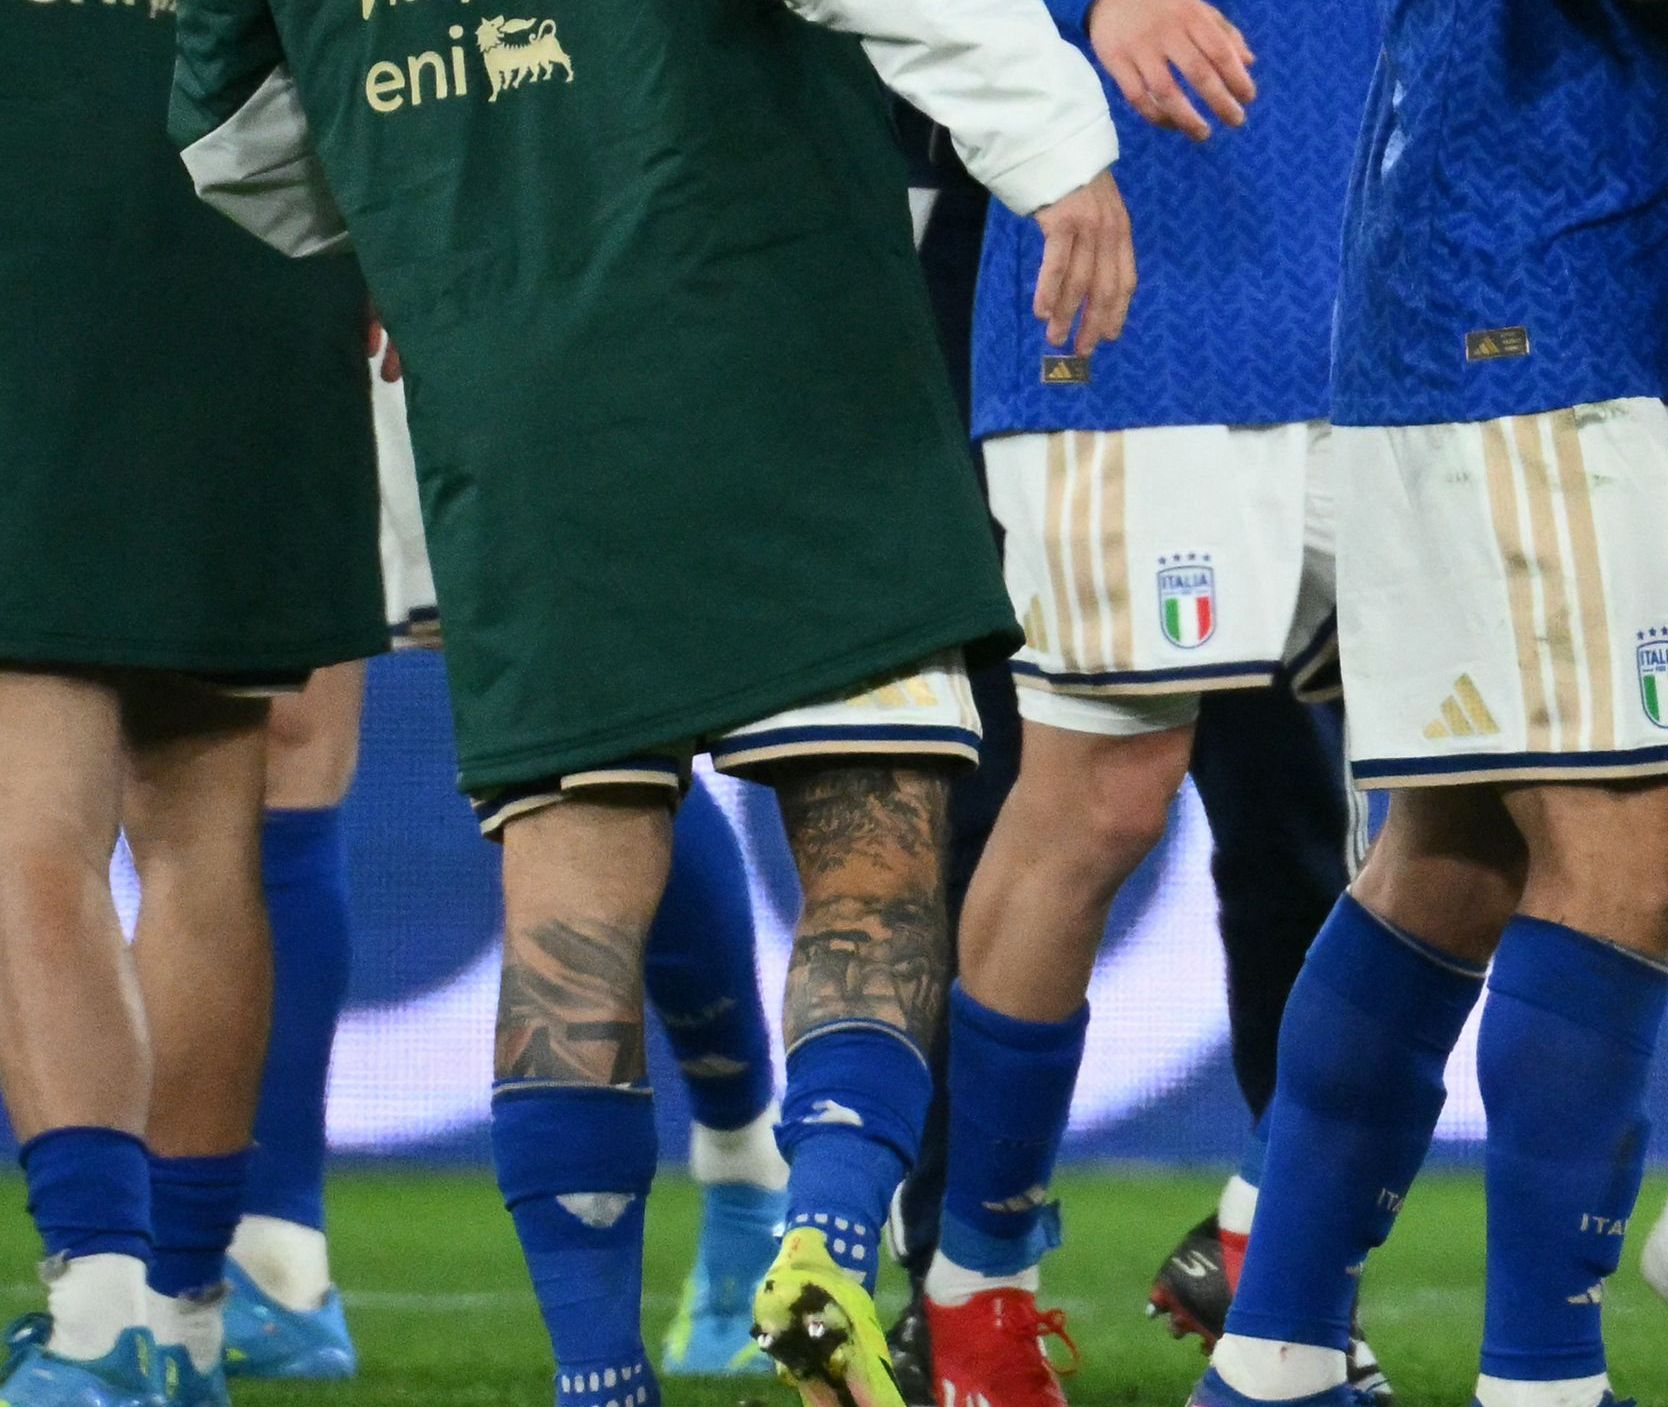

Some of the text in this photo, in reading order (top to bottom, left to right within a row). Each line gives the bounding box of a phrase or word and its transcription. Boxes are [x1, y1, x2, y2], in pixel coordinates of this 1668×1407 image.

[365, 25, 468, 113] eni
[1162, 573, 1208, 590] ITALIA
[1580, 1213, 1628, 1235] ITA
